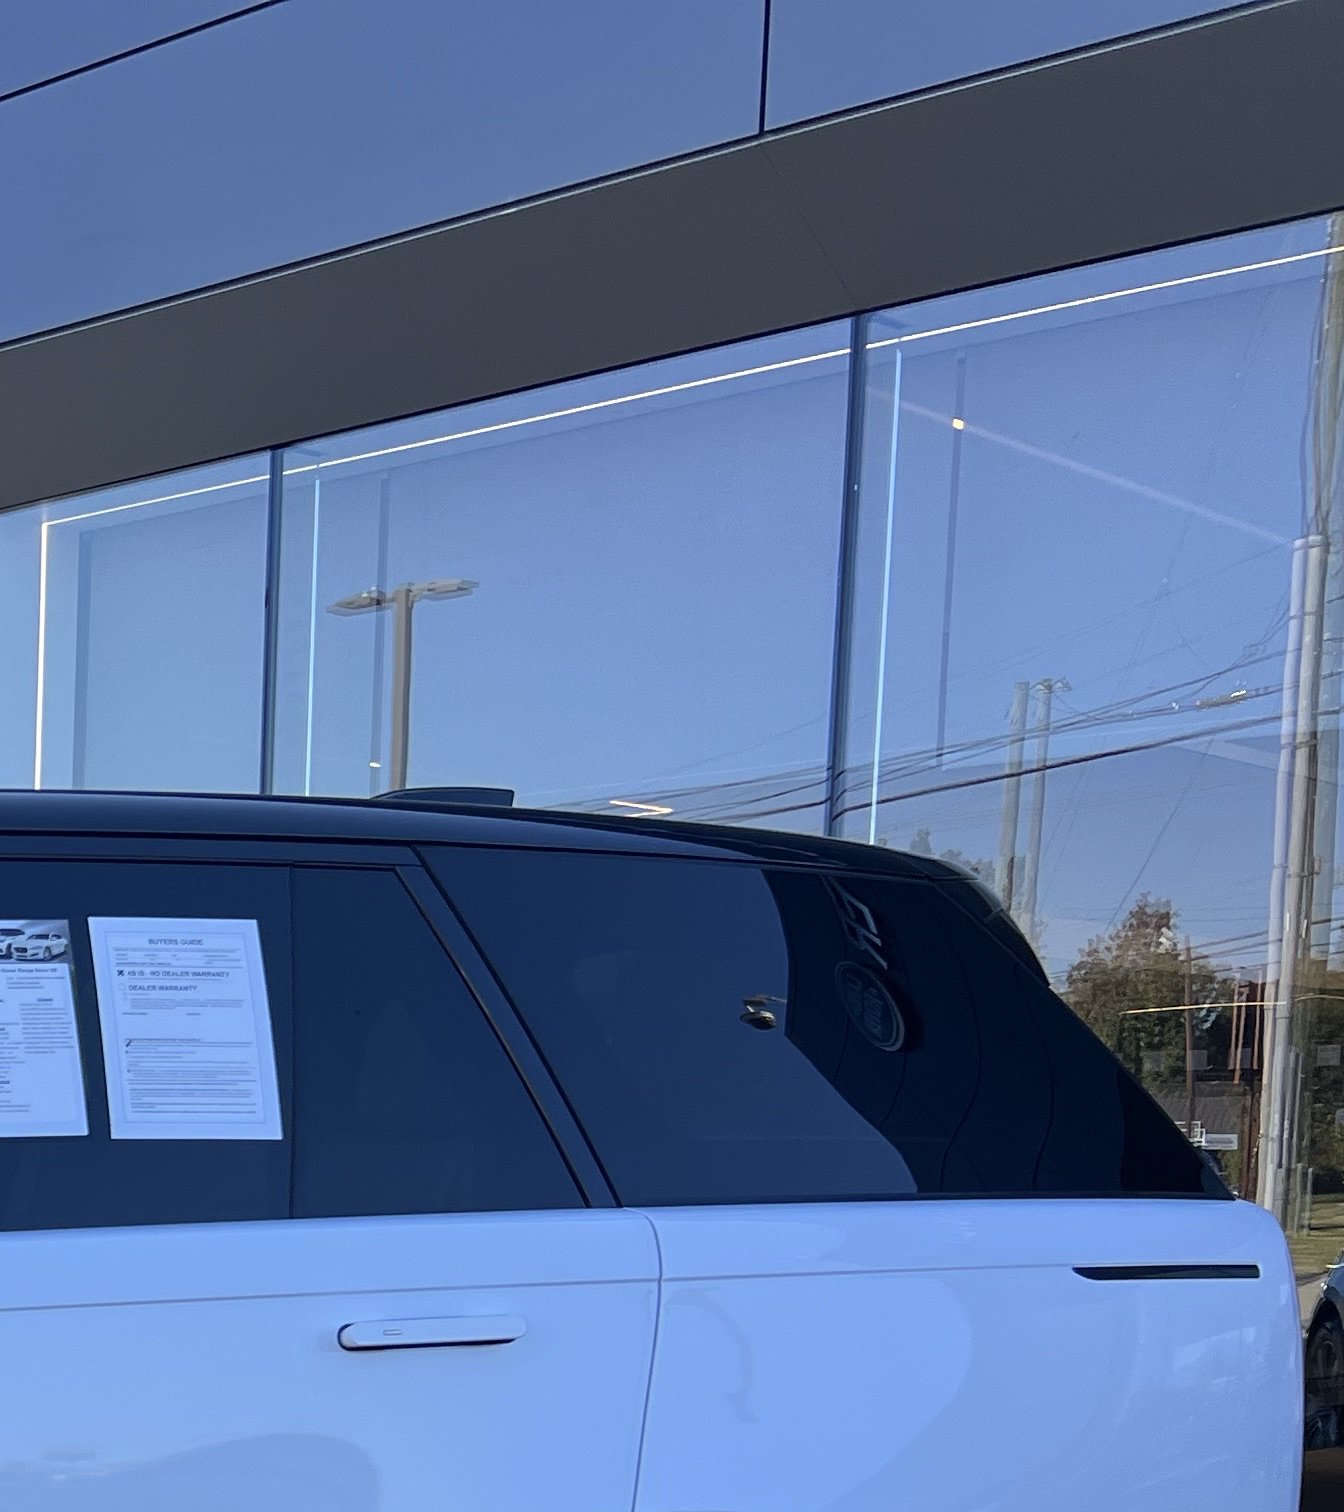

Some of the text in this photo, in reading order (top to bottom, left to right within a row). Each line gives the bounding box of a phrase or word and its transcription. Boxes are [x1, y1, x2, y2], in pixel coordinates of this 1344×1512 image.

[148, 938, 204, 946] BUYERS GUIDE
[128, 984, 198, 992] DEALER WARRANTY
